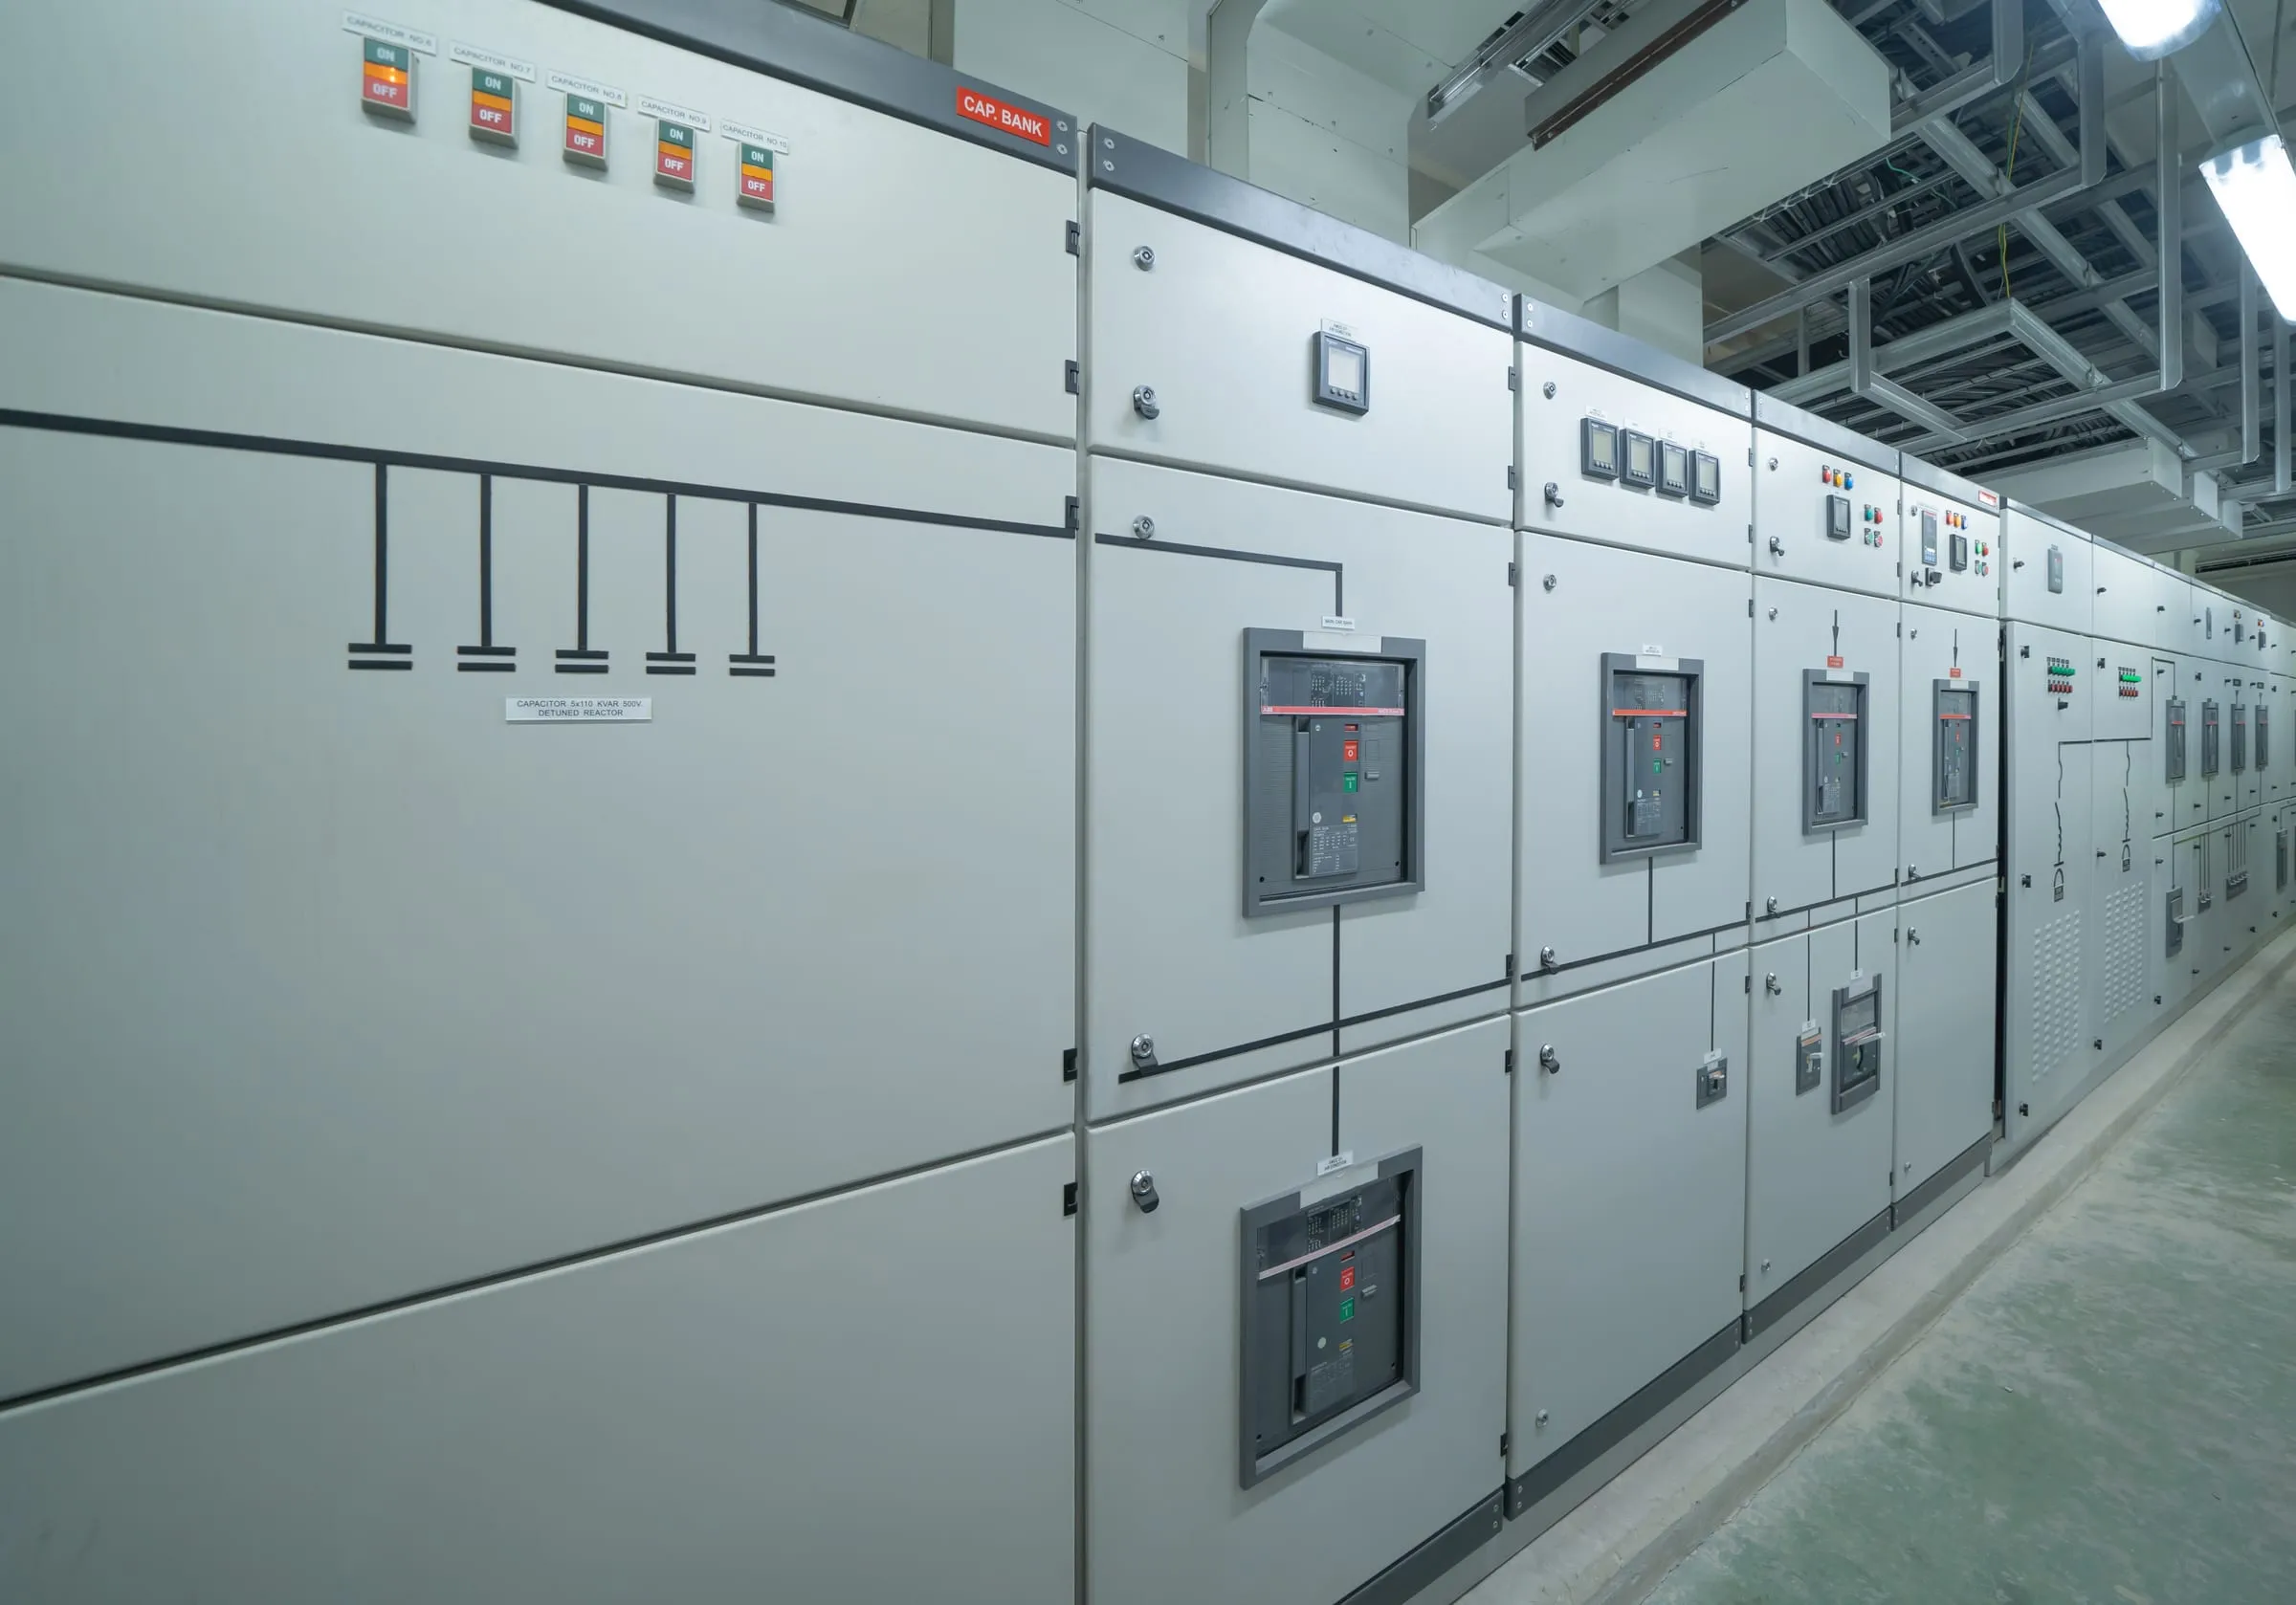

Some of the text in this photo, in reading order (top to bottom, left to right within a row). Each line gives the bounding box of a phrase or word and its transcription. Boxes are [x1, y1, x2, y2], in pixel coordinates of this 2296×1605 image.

[346, 16, 405, 37] CAPACITOR
[377, 46, 395, 61] ON
[453, 47, 531, 74] CAPACITOR NO.7
[373, 82, 398, 99] OFF
[485, 76, 501, 91] ON
[551, 76, 600, 93] CAPACITOR
[479, 109, 502, 123] OFF
[579, 102, 594, 116] ON
[641, 100, 685, 119] CAPACITOR
[963, 96, 1043, 138] CAP. BANK
[669, 128, 684, 142] ON
[722, 124, 763, 142] CAPACITOR
[573, 134, 595, 149] OFF
[751, 150, 764, 163] ON
[664, 158, 684, 171] OFF
[747, 180, 765, 192] OFF
